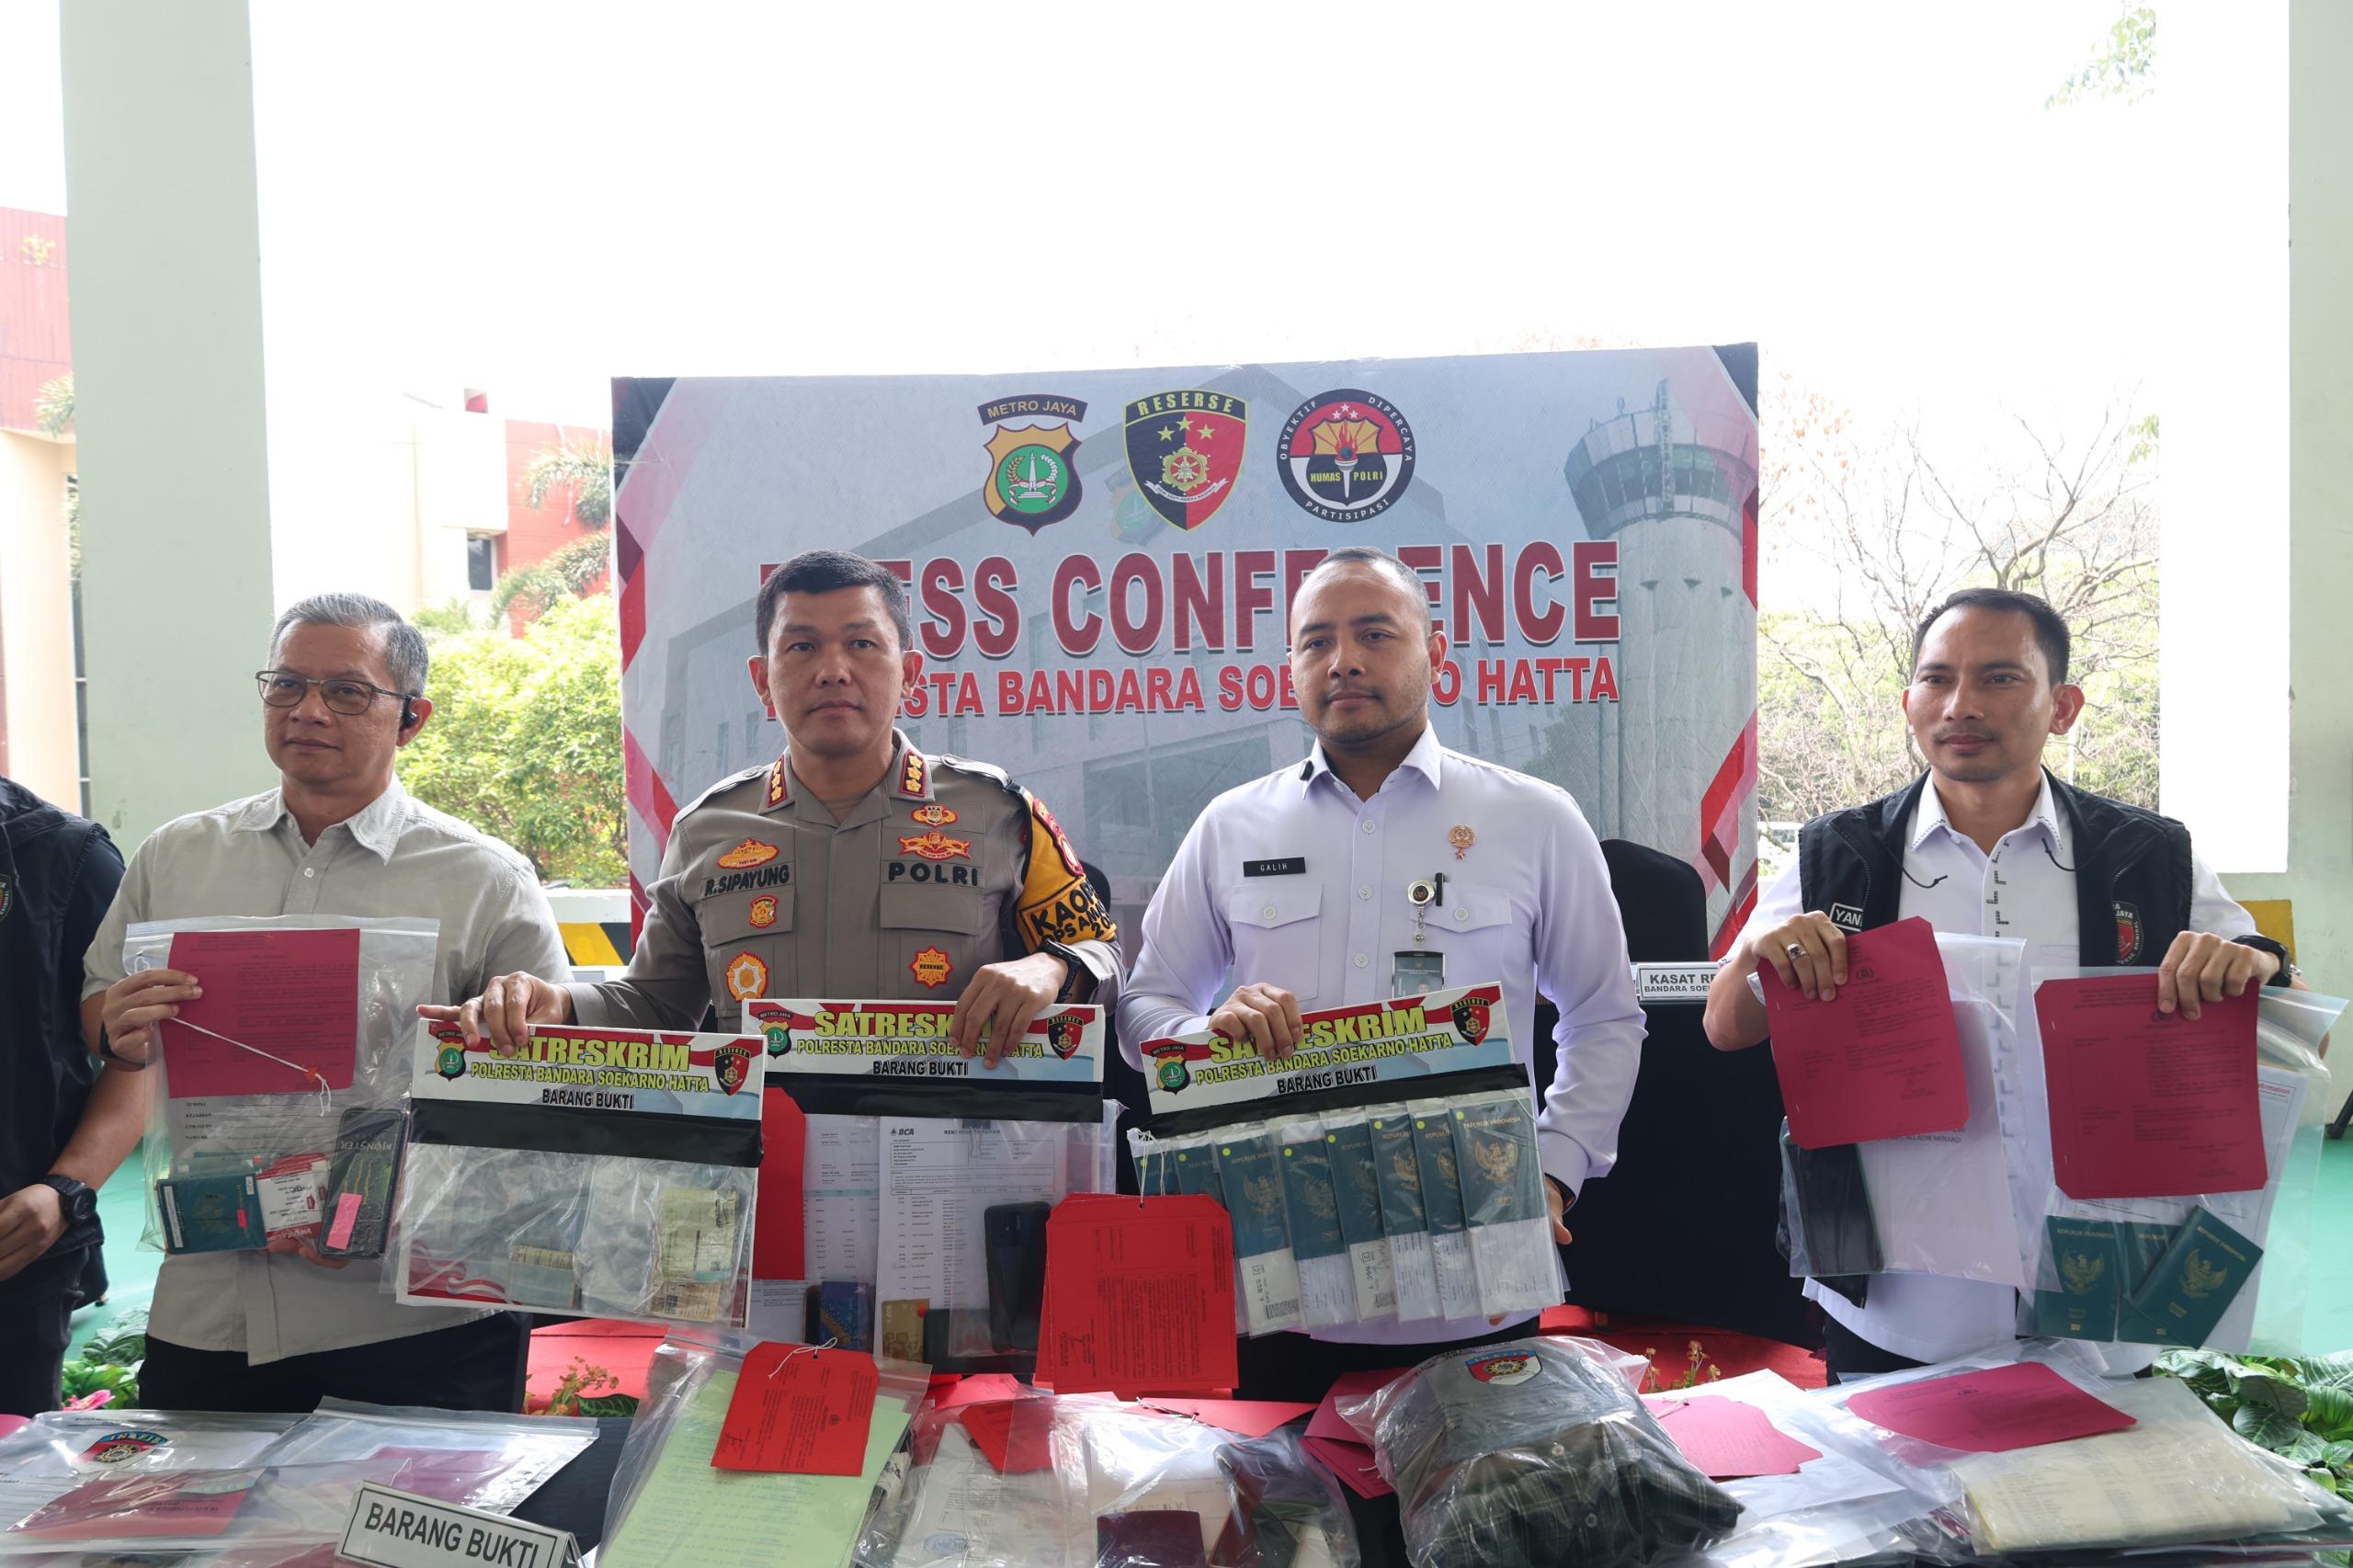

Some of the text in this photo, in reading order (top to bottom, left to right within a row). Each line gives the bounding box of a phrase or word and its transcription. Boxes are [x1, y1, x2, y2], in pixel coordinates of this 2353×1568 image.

[987, 400, 1076, 418] METRO JAYA
[1137, 392, 1233, 416] RESERSE
[1279, 400, 1317, 460] OBYEKTIF
[1369, 396, 1413, 461] DIPERCAYA
[1311, 471, 1383, 483] HUMAS POLRI
[1305, 499, 1389, 520] PARTISIPASI
[1051, 540, 1620, 656] CONFNCE
[998, 665, 1204, 716] BANDARA
[1218, 663, 1462, 711] SOEO
[1477, 656, 1619, 704] HATTA
[705, 864, 790, 896] R.SIPAYUNG
[889, 861, 978, 886] POLRI
[1260, 862, 1288, 872] GALIH
[1650, 974, 1696, 984] KASAT
[813, 1010, 995, 1039] SATRESKI
[1208, 1006, 1427, 1064] SAESKRIM
[797, 1039, 864, 1054] POLRESTA
[866, 1040, 926, 1056] BANDARA
[1010, 1042, 1044, 1058] ATTA
[1195, 1032, 1453, 1085] POLRESTA BANDARA SOEKARNO HATTA
[471, 1062, 710, 1094] POLRESTA BANDARA SOEKARNO HATTA
[873, 1061, 969, 1076] BARANG BUKTI
[1277, 1064, 1377, 1094] BARANG BUKTI
[542, 1088, 634, 1109] BARANG BUKTI
[898, 1128, 915, 1136] BCA
[365, 1502, 540, 1568] BARANG BUKTI
